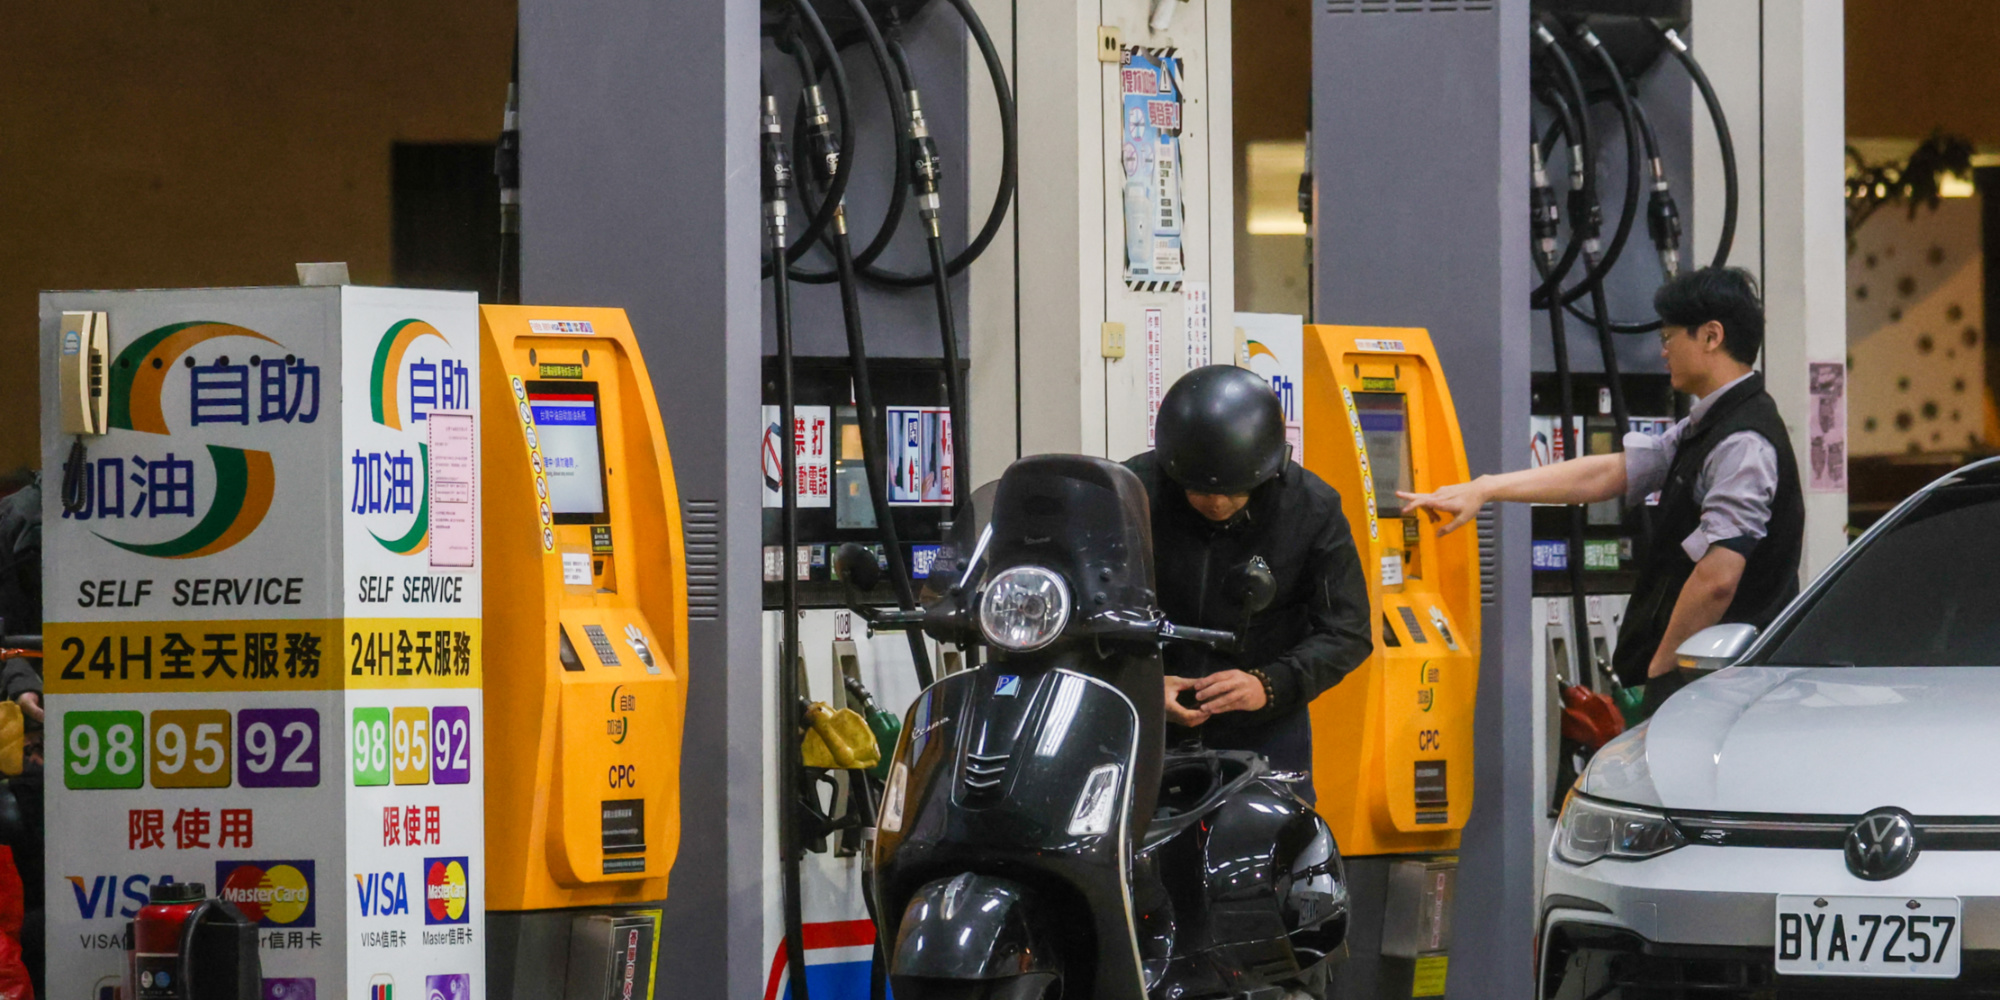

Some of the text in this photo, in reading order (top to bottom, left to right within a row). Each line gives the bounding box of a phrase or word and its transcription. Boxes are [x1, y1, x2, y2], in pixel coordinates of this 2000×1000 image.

[190, 358, 320, 426] 自助
[409, 356, 469, 423] 自助
[61, 452, 195, 520] 加油
[351, 449, 414, 515] 加油
[796, 465, 828, 495] 動電話
[77, 577, 304, 608] SELF SERVICE
[358, 575, 463, 603] SELF SERVICE
[60, 632, 322, 680] 24H全天服務
[351, 629, 471, 677] 24H全天服務
[69, 721, 314, 775] 98 95 92
[354, 718, 468, 772] 98 95 92
[1419, 729, 1440, 751] CPC
[608, 764, 636, 789] CPC
[128, 808, 255, 851] 限使用
[383, 805, 441, 847] 限使用
[224, 885, 308, 903] MasterCard
[354, 871, 409, 917] VISA
[427, 882, 467, 900] MasterCard
[361, 930, 407, 948] VISA信用卡
[422, 927, 473, 946] Master信用卡
